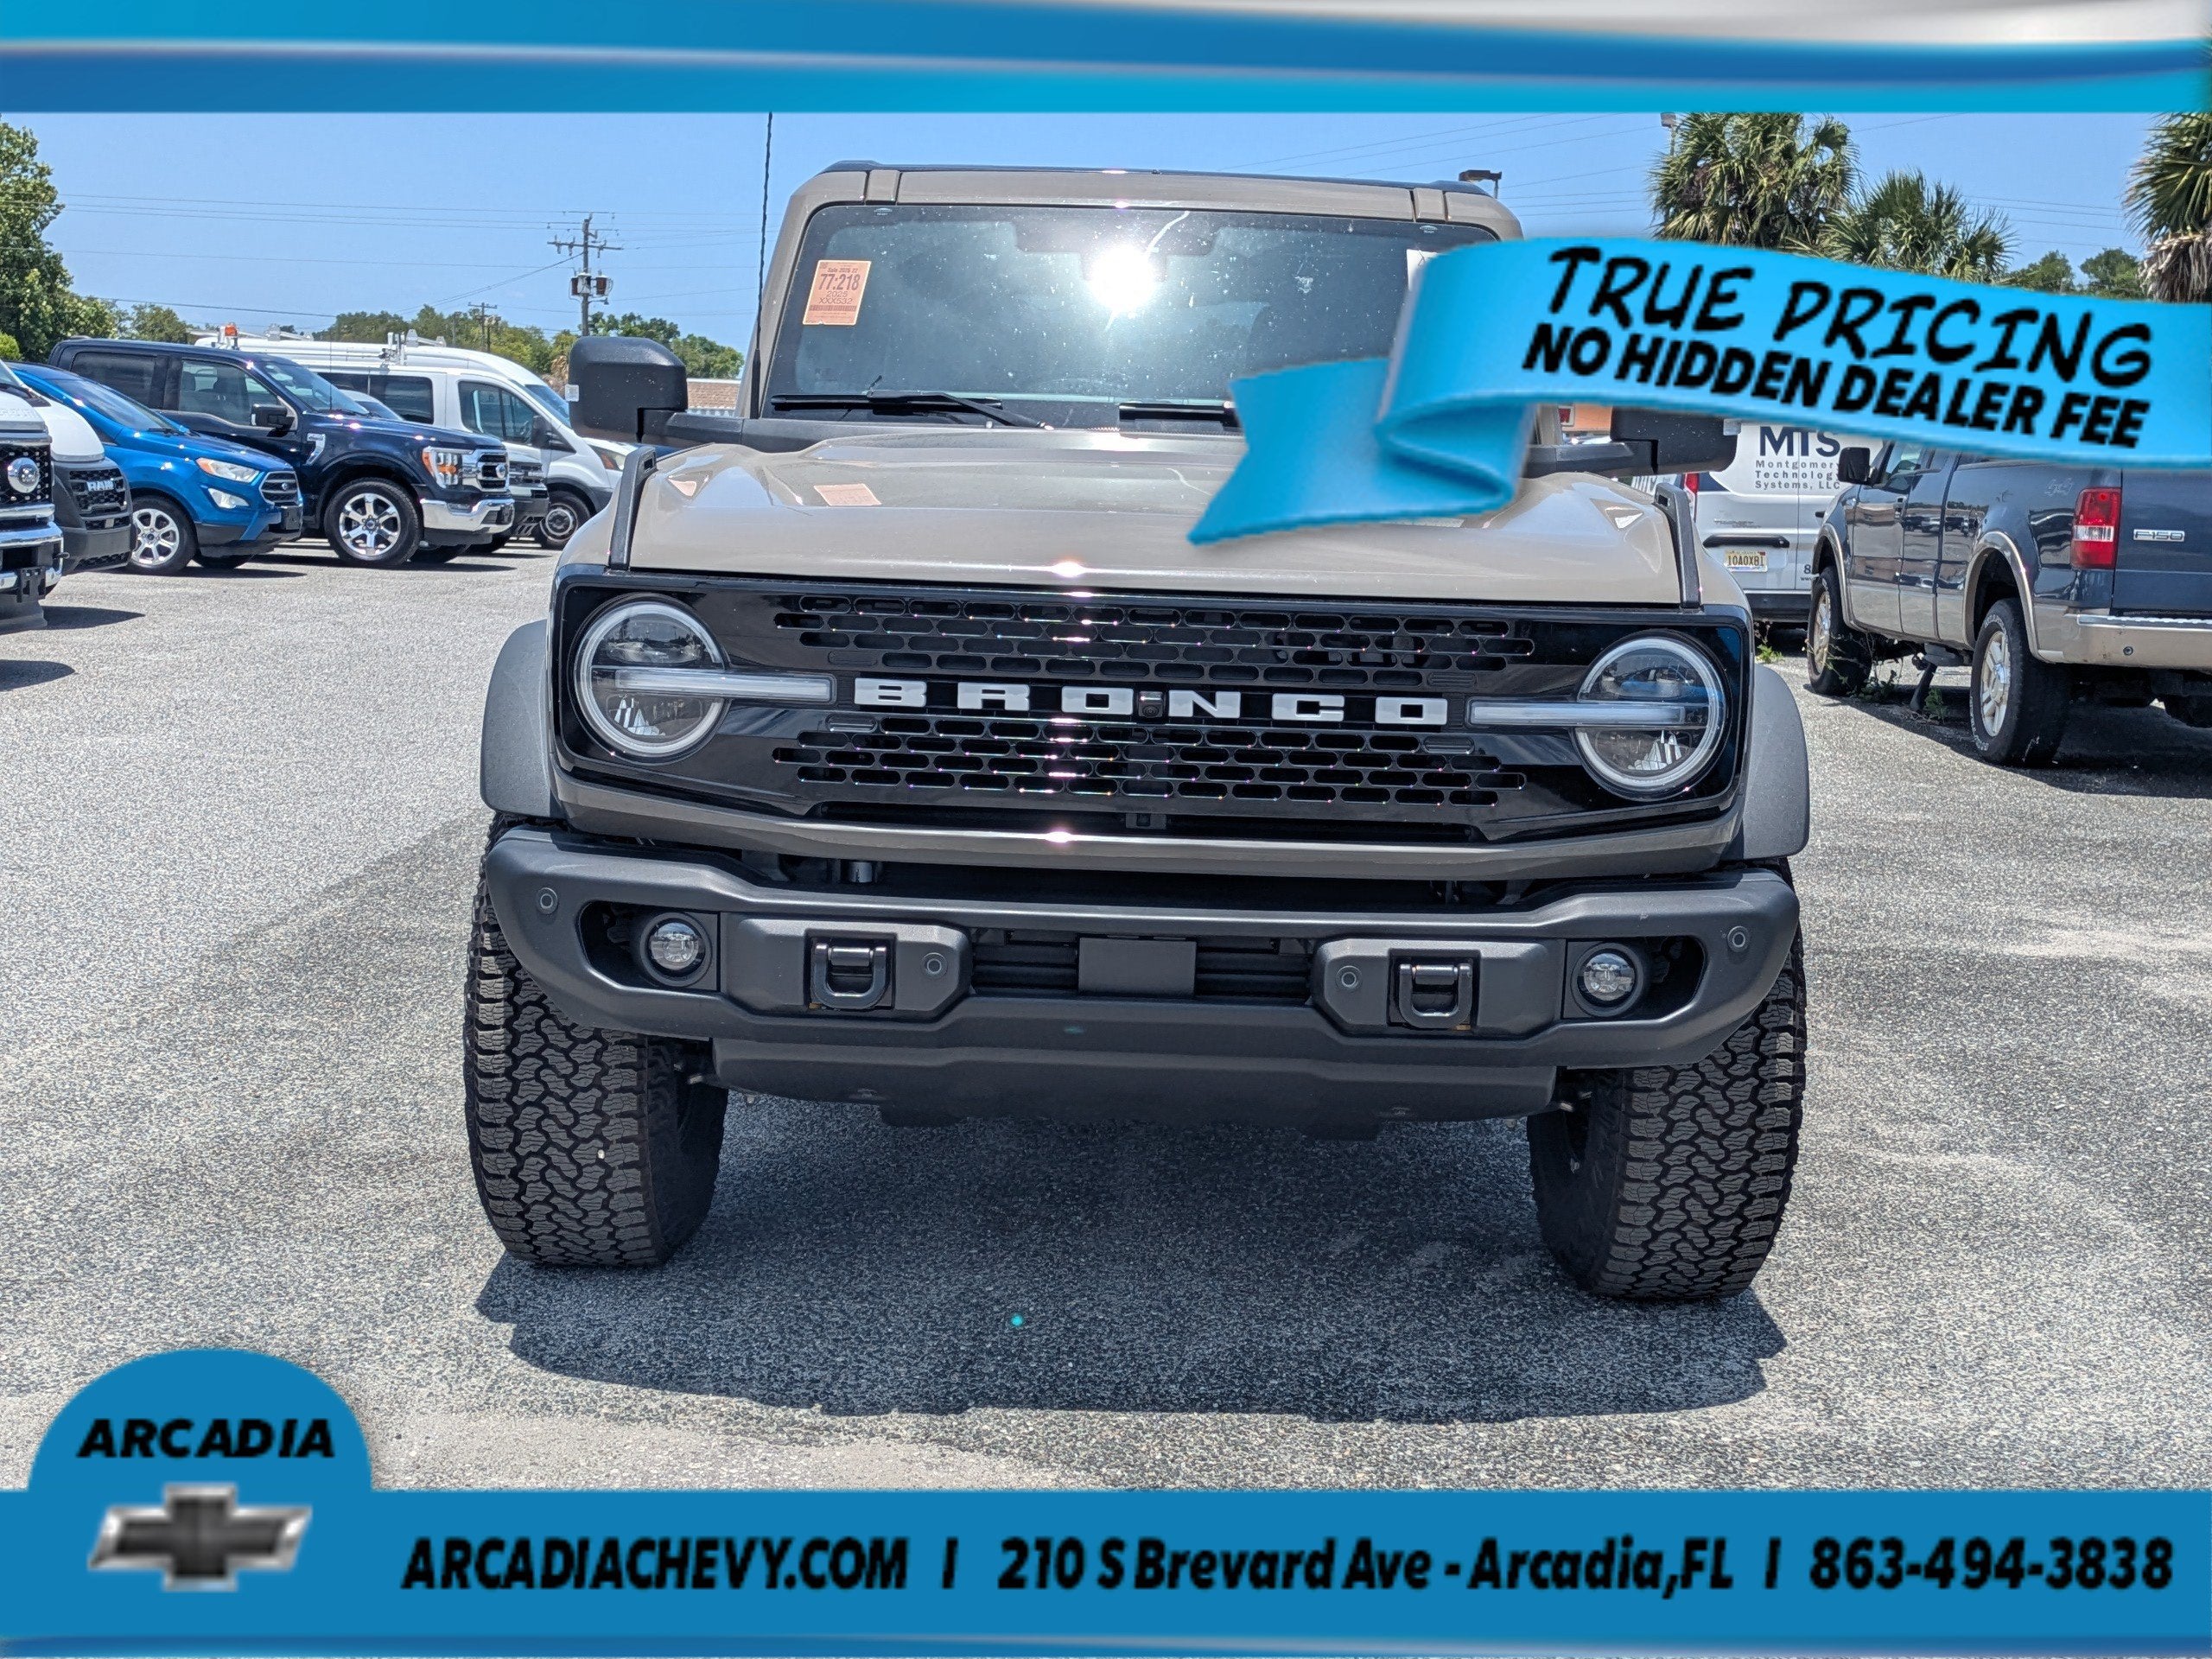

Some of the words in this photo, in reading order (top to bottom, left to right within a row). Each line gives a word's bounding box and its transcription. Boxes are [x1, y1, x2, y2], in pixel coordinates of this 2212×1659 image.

[818, 273, 861, 290] 77:218
[1759, 426, 1840, 457] MTS
[1755, 470, 1838, 481] Technolog
[86, 480, 114, 492] RAM
[1755, 480, 1813, 490] Systems,
[1819, 480, 1840, 490] LLC
[2134, 530, 2184, 542] F-150
[854, 677, 1448, 726] BRONCO
